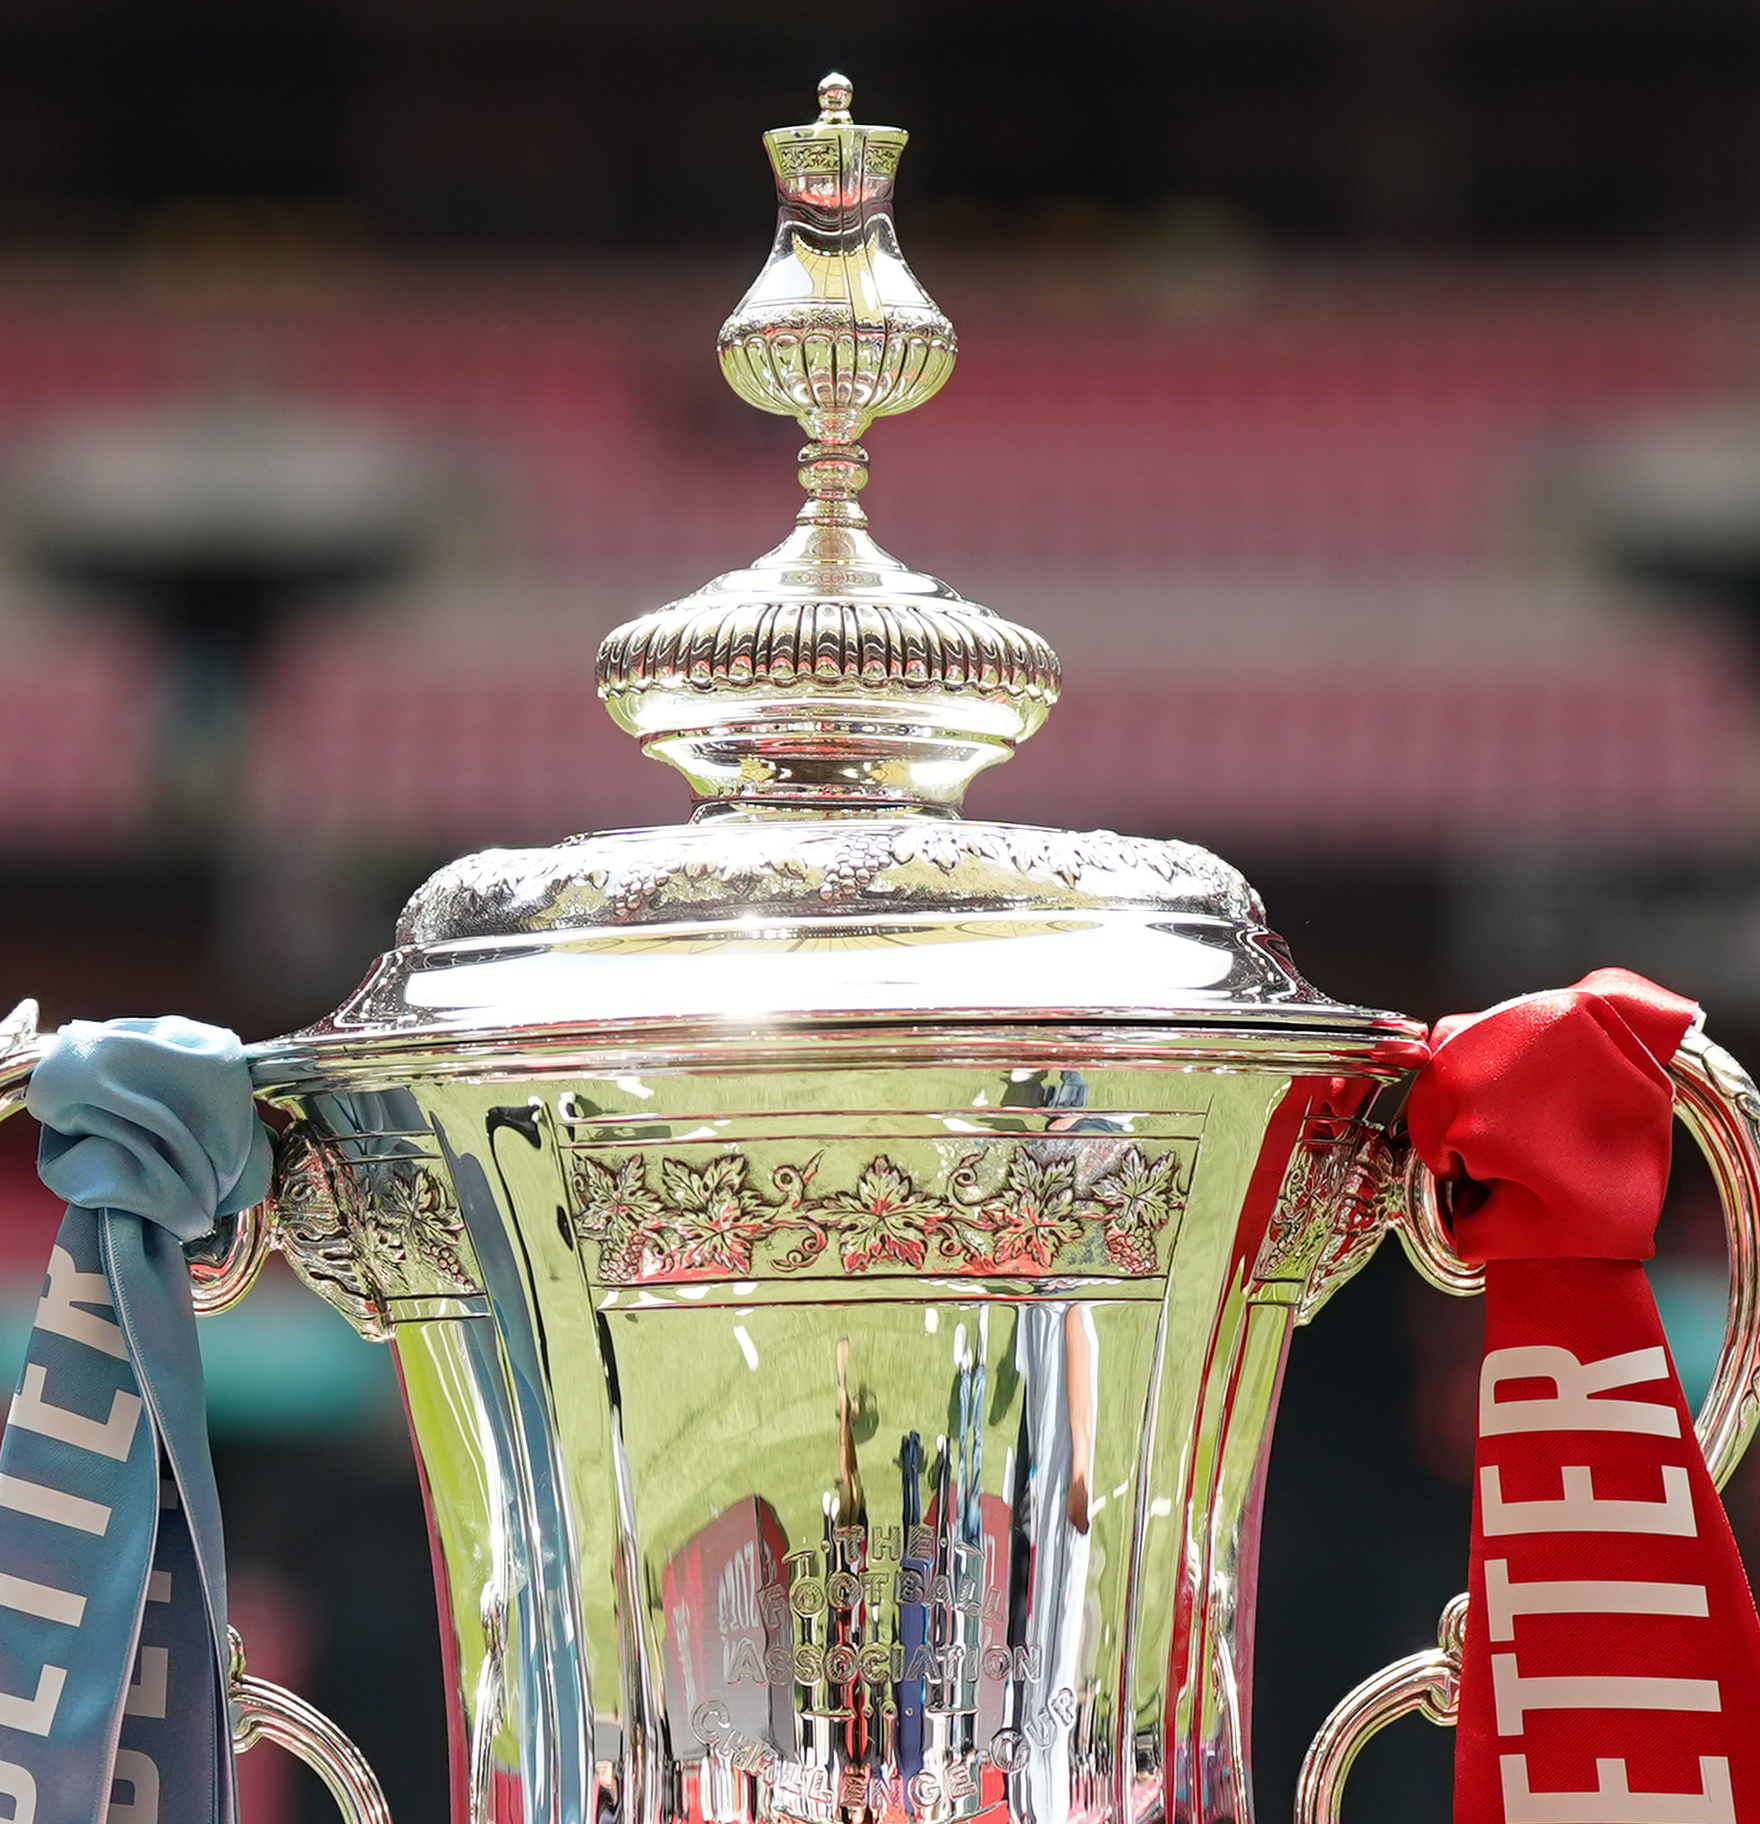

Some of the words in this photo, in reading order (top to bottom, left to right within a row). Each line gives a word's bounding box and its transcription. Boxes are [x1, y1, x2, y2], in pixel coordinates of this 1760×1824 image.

[834, 1524, 937, 1563] THE
[756, 1567, 1008, 1631] FOOTBALL
[727, 1638, 1042, 1686] ASSOCIATION
[988, 1687, 1077, 1774] CUP
